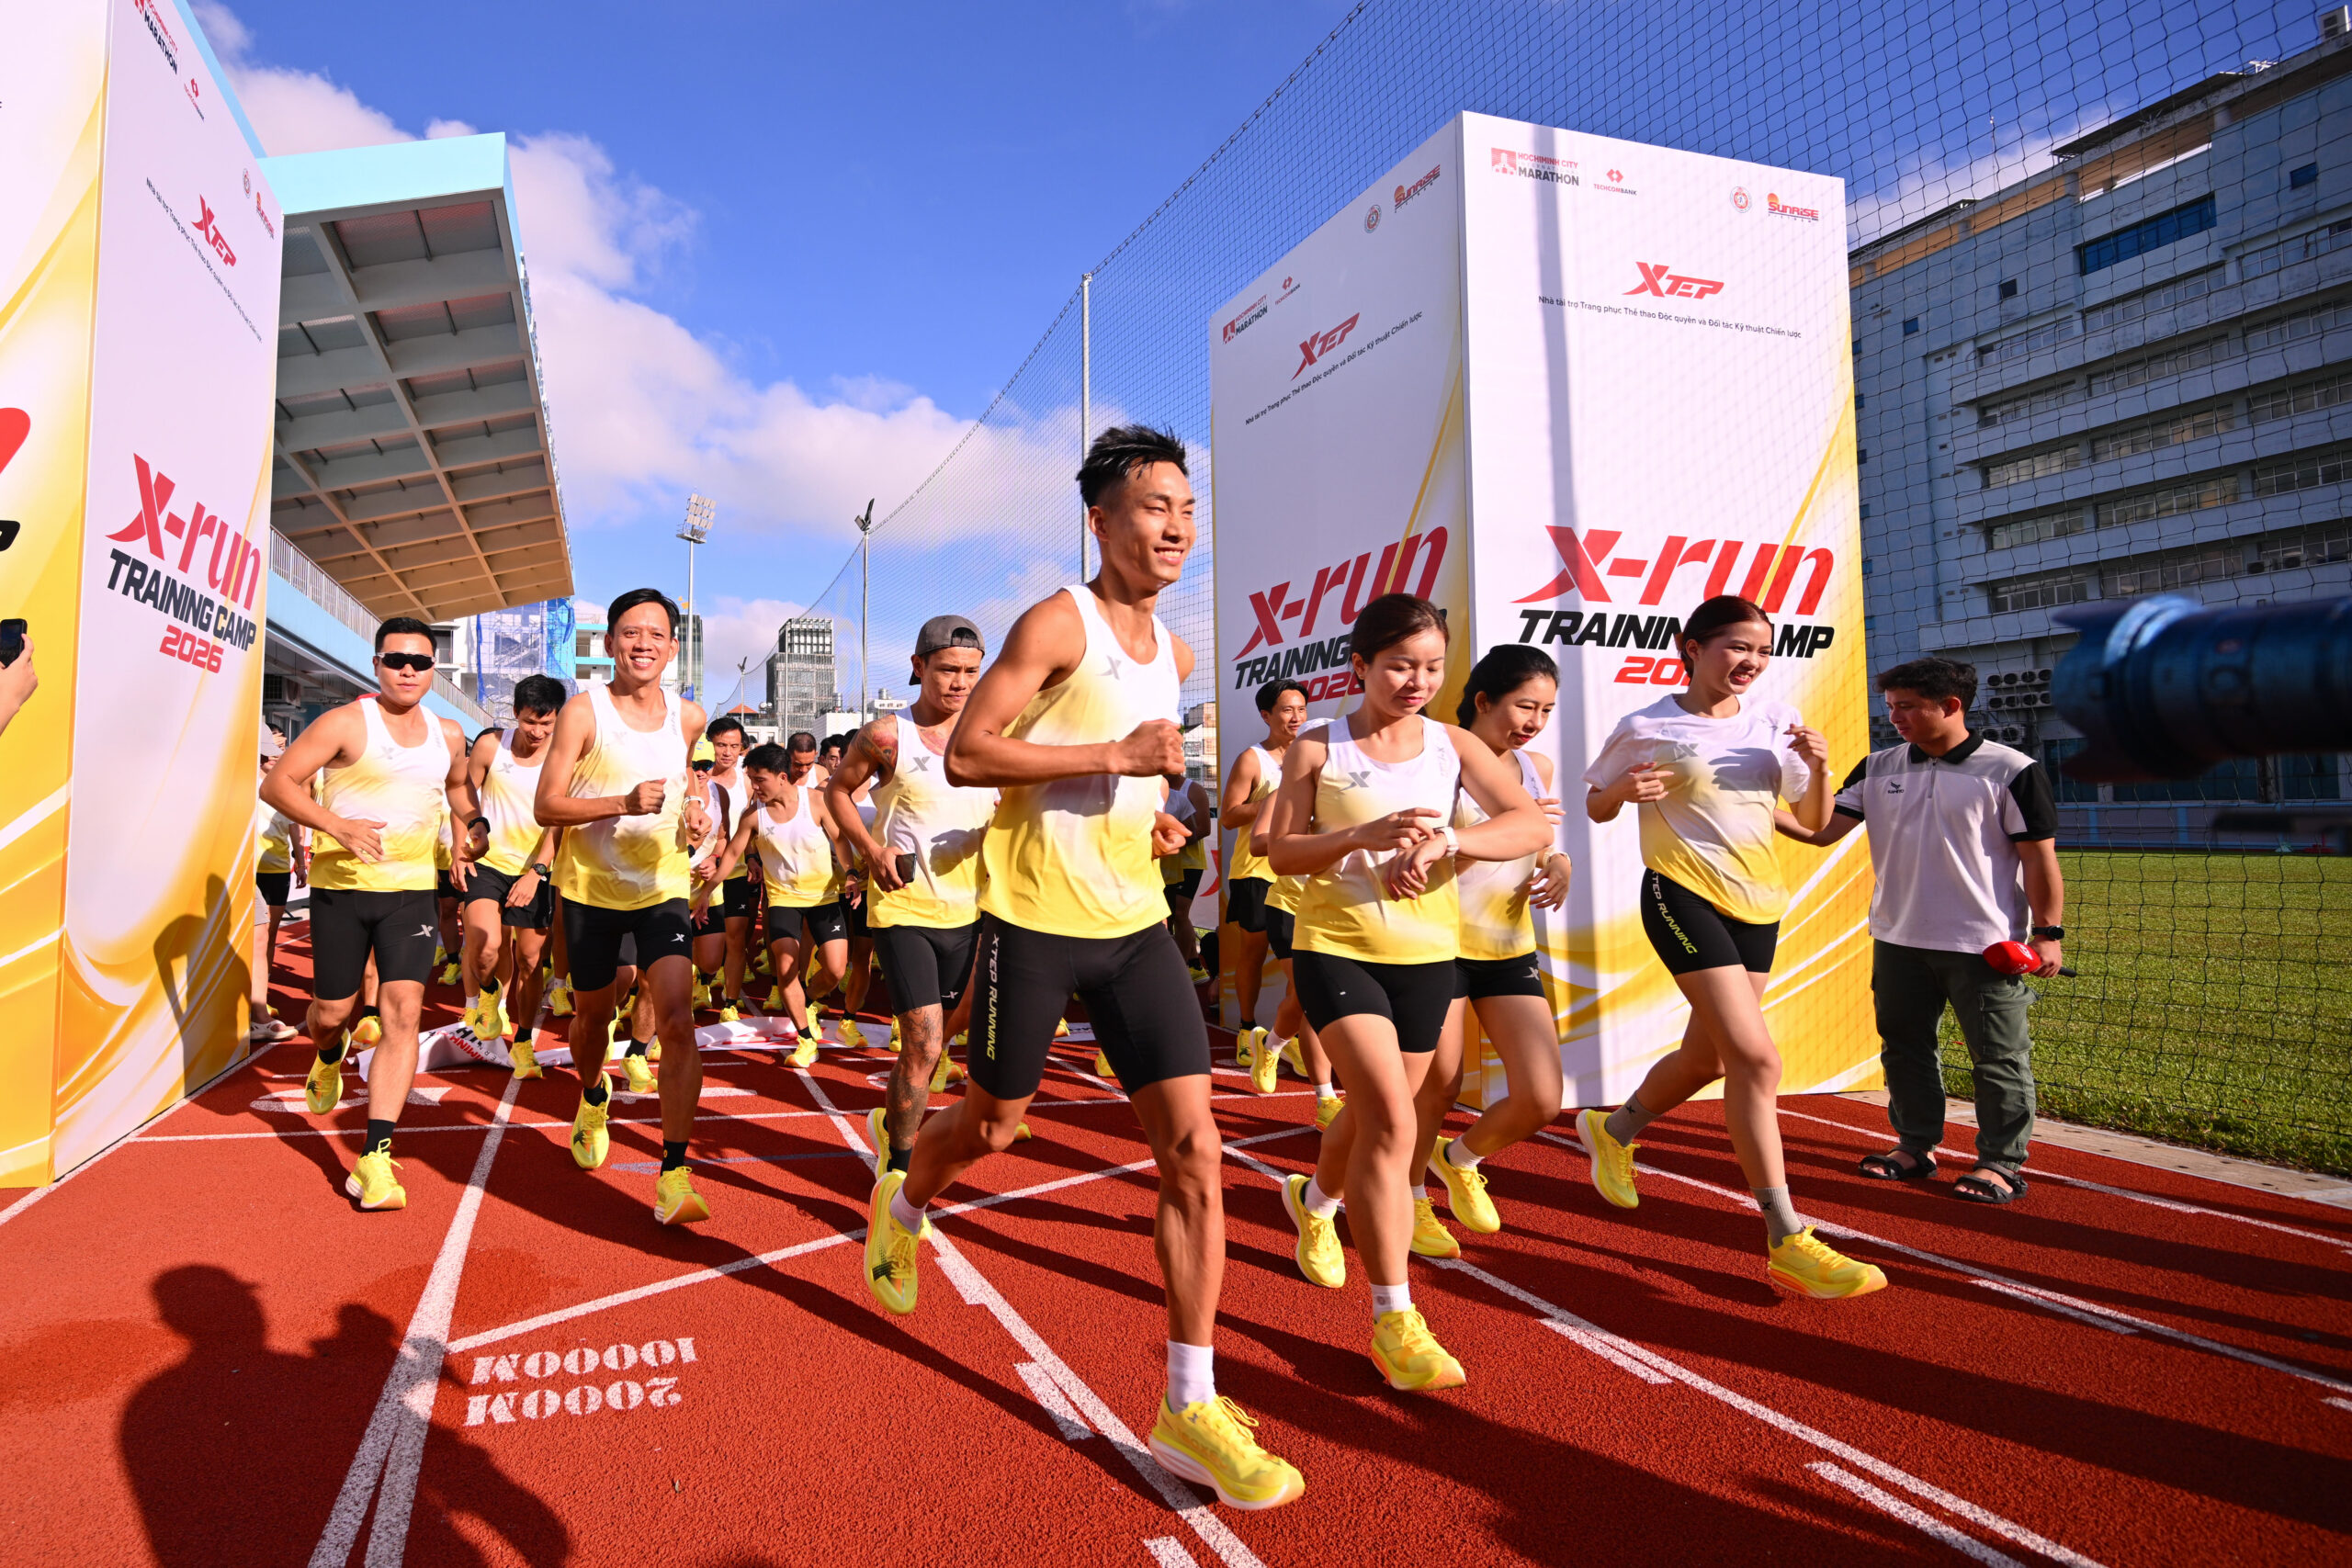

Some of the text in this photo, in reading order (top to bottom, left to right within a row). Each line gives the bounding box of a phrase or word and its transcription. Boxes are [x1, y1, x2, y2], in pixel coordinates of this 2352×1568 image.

[143, 9, 177, 75] MARATHON
[1518, 152, 1579, 170] HOCHIMINH CITY
[1518, 166, 1580, 186] MARATHON
[1593, 183, 1638, 197] TECHCOMBANK
[191, 193, 237, 267] XTEP
[1622, 261, 1725, 300] XTEP
[1236, 305, 1269, 336] MARATHON
[1538, 296, 1555, 306] Nhà
[1555, 298, 1566, 307] tài
[1567, 300, 1579, 310] trợ
[1580, 301, 1602, 313] Trang
[1603, 305, 1622, 316] phục
[1623, 307, 1638, 317] Thể
[1639, 310, 1657, 319] thao
[1657, 311, 1673, 322] Độc
[1674, 315, 1697, 327] quyền
[1698, 318, 1707, 326] và
[1708, 318, 1721, 328] Đối
[1722, 321, 1734, 330] tác
[1746, 324, 1765, 334] thuật
[1765, 326, 1786, 336] Chiến
[1289, 312, 1360, 381] XTEP
[1245, 417, 1255, 426] Nhà
[1267, 400, 1280, 412] Trang
[1280, 393, 1292, 406] phục
[1292, 385, 1301, 397] Thể
[1301, 380, 1312, 392] thao
[1312, 373, 1323, 386] Độc
[1323, 363, 1340, 378] quyền
[1340, 358, 1347, 368] và
[1347, 351, 1357, 363] Đối
[1357, 346, 1366, 357] tác
[1374, 331, 1391, 345] thuật
[1391, 319, 1408, 335] Chiến
[107, 547, 257, 652] TRAINING CAMP
[159, 625, 224, 675] 2026
[1657, 902, 1698, 954] RUNNING
[987, 932, 1000, 1062] XTEP RUNNING
[470, 1337, 699, 1385] 10000M
[463, 1376, 683, 1427] 2000M
